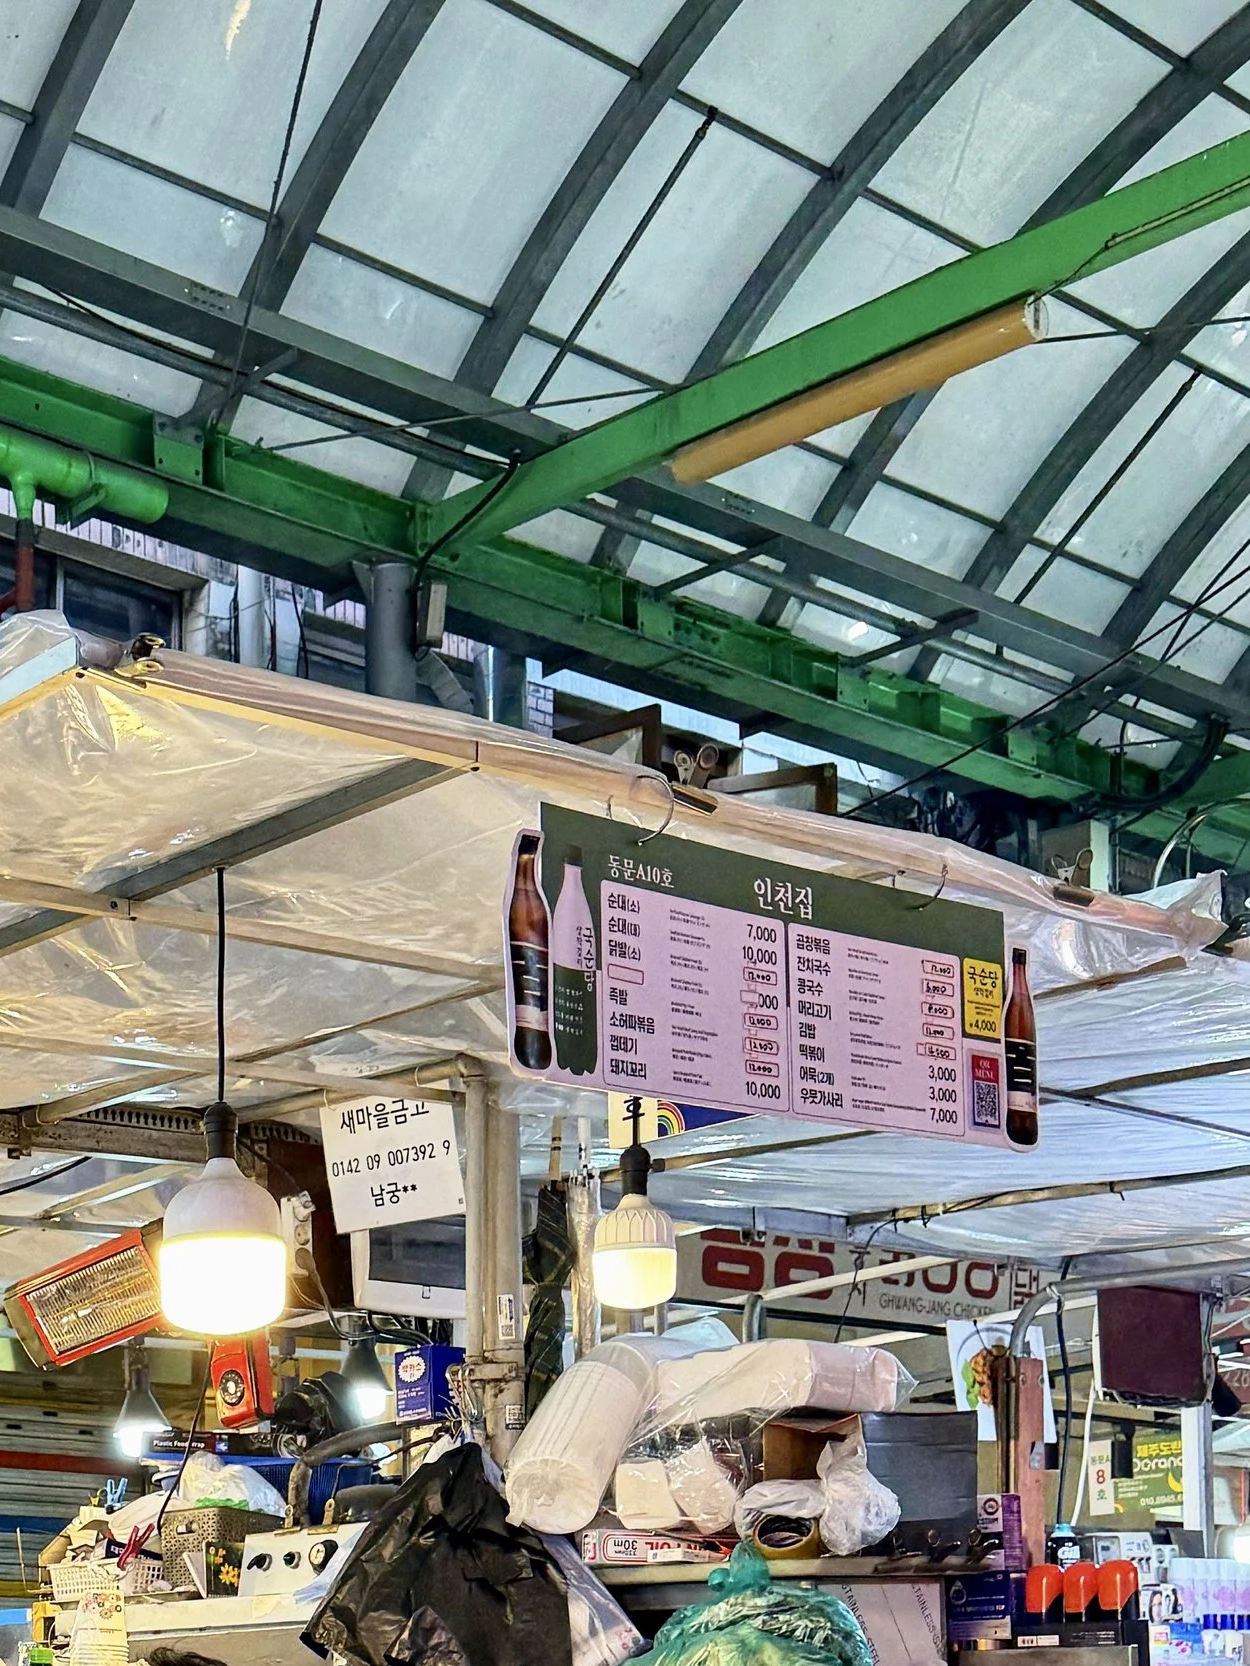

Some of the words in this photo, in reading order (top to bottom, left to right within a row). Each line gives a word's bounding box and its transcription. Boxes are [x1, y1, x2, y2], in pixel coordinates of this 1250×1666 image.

[608, 855, 674, 889] 동문A10호
[608, 892, 640, 914] 순대(소)
[753, 878, 813, 920] 인천집
[608, 917, 641, 938] 순대(대)
[746, 923, 777, 944] 7,000
[608, 939, 641, 962] 닭발(소)
[796, 934, 831, 955] 곱창볶음
[583, 927, 595, 992] 국순당
[742, 945, 777, 966] 10,000
[797, 956, 831, 976] 잔치국수
[797, 977, 823, 996] 콩국수
[968, 966, 999, 988] 국순당
[609, 988, 629, 1006] 족발
[798, 1000, 832, 1020] 머리고기
[799, 1022, 817, 1039] 김밥
[610, 1035, 638, 1056] 껍데기
[799, 1043, 825, 1063] 떡볶이
[610, 1059, 647, 1081] 돼지꼬리
[800, 1065, 835, 1086] 어묵(2개)
[928, 1065, 956, 1082] 3,000
[746, 1081, 781, 1100] 10,000
[929, 1086, 957, 1103] 3,000
[340, 1099, 430, 1135] 새마을금고
[930, 1108, 957, 1124] 7,000
[332, 1158, 361, 1177] 0142
[366, 1153, 381, 1171] 09
[387, 1142, 436, 1167] 007392
[442, 1139, 451, 1156] 9
[190, 1441, 206, 1449] rap
[1096, 1469, 1106, 1485] 8
[613, 1539, 638, 1550] 30m
